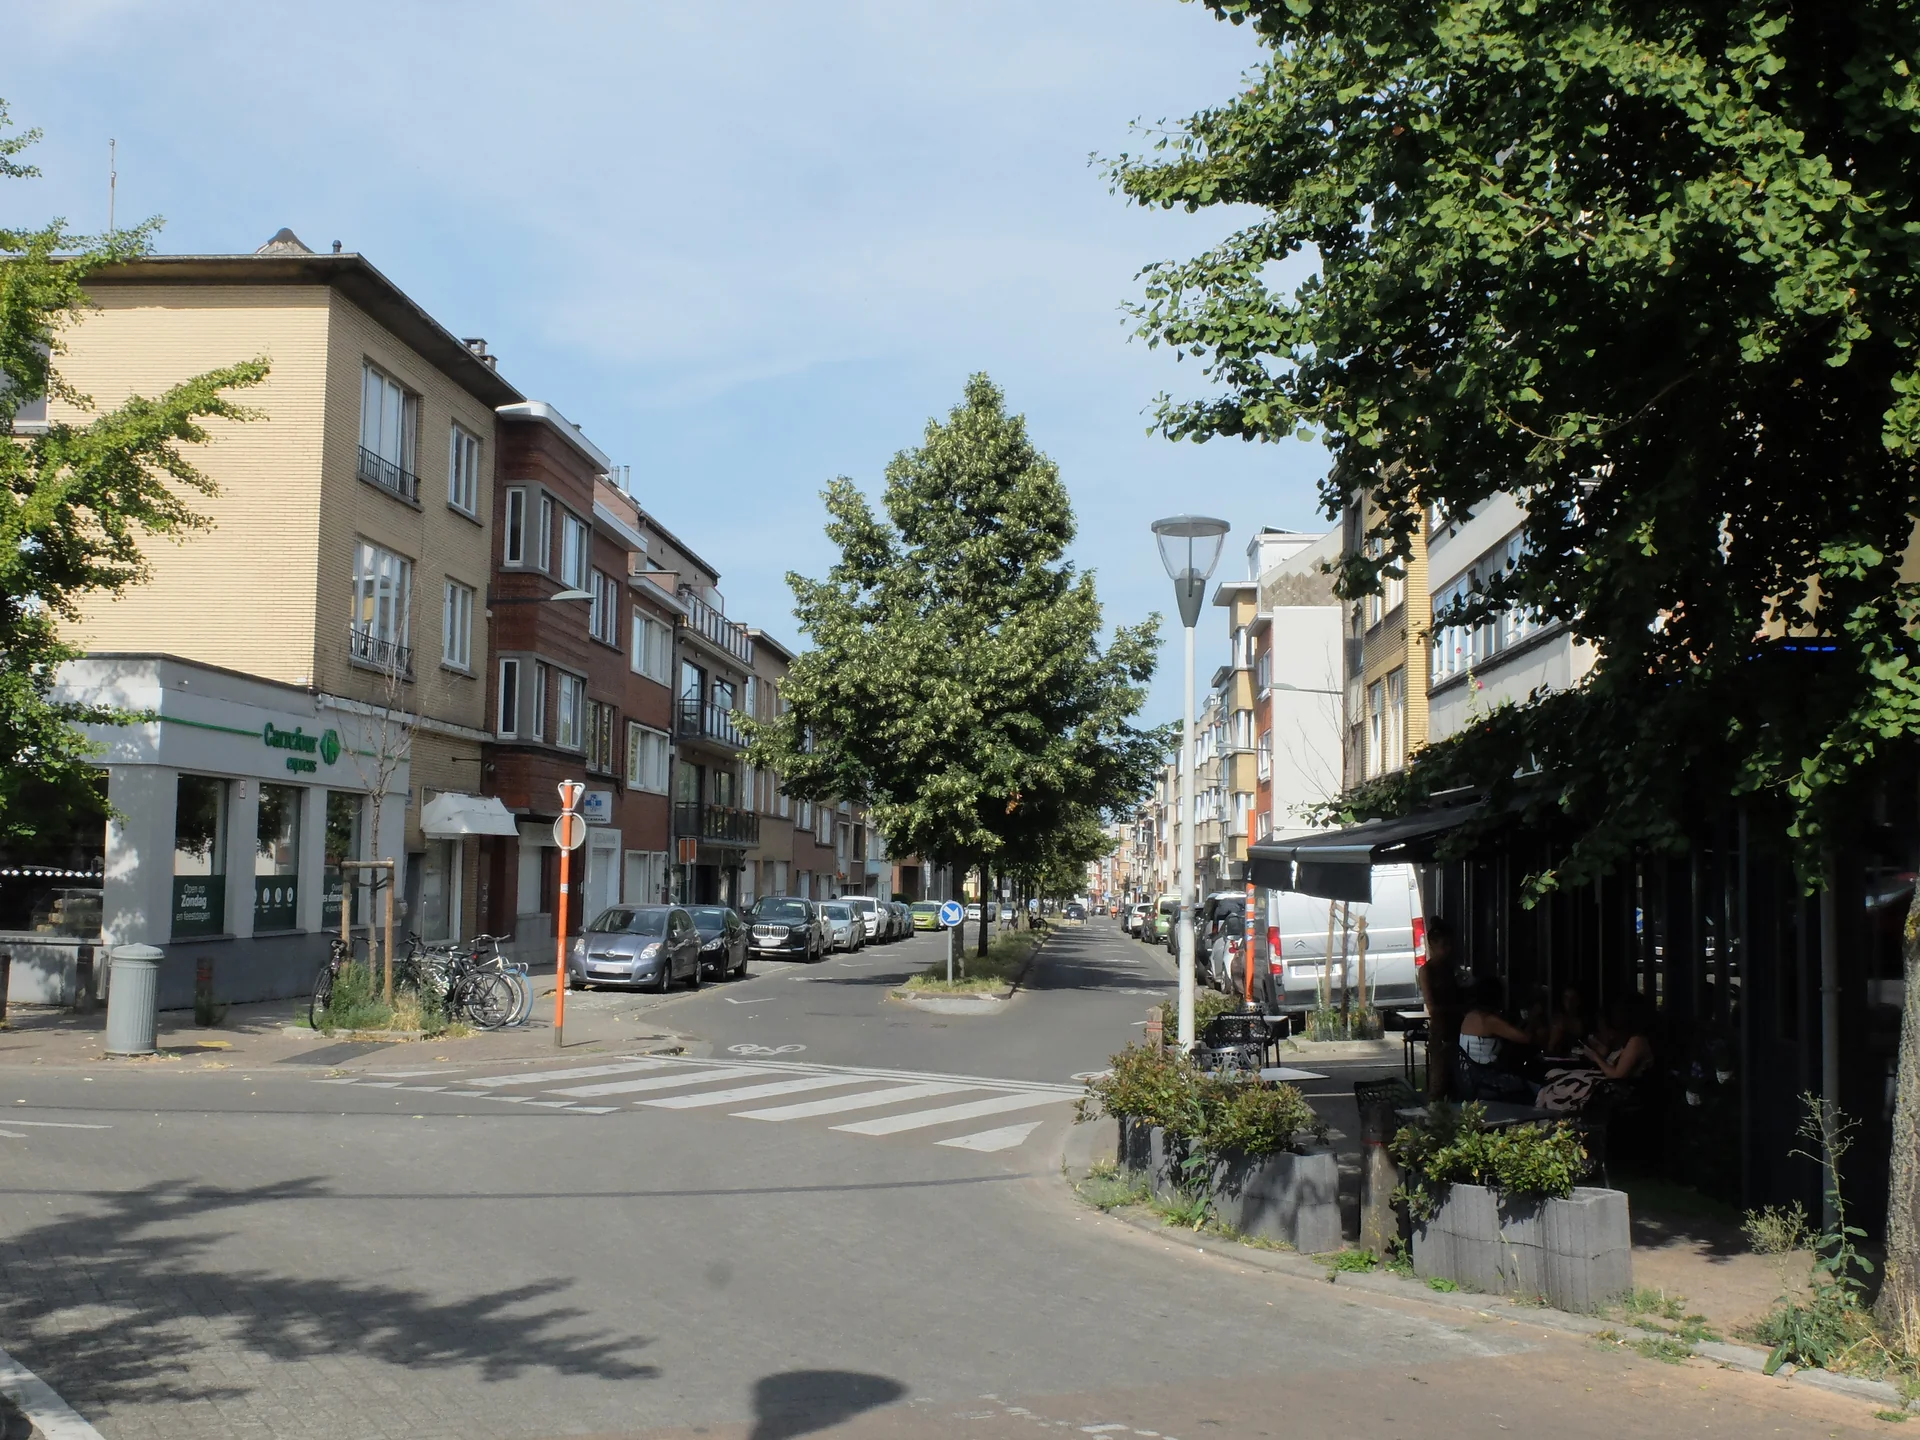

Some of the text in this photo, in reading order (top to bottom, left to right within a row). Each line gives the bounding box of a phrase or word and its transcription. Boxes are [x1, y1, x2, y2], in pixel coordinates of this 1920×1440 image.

[184, 883, 206, 895] Open op
[180, 894, 207, 910] Zondag
